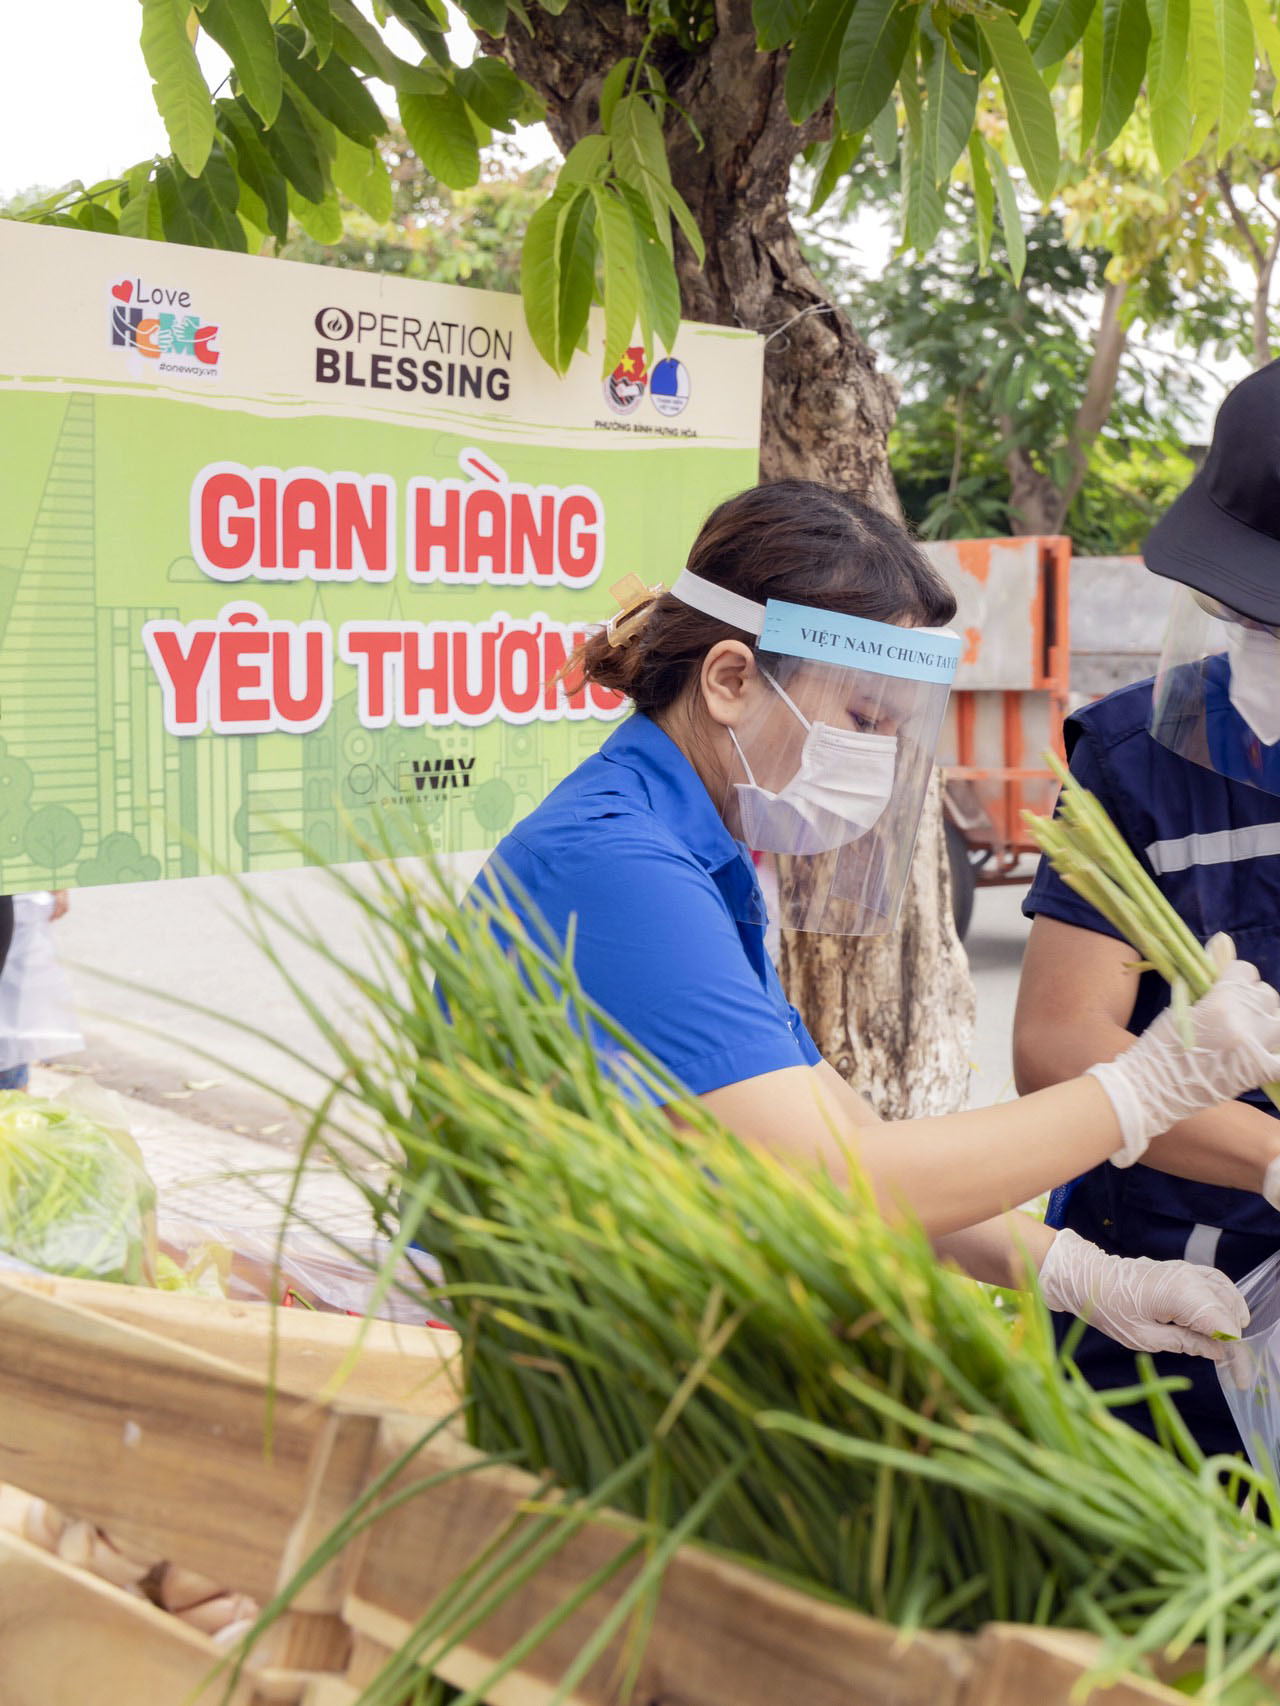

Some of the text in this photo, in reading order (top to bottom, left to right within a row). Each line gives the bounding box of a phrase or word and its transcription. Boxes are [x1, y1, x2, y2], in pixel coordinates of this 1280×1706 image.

[136, 278, 191, 308] Love
[315, 307, 513, 361] OPERATION
[159, 362, 218, 377] #oneway.vn
[316, 347, 510, 401] BLESSING
[201, 458, 597, 578] GIAN HÀNG
[153, 612, 323, 723] YÊU
[800, 627, 841, 648] VIỆT
[843, 636, 882, 656] NAM
[886, 645, 934, 666] CHUNG
